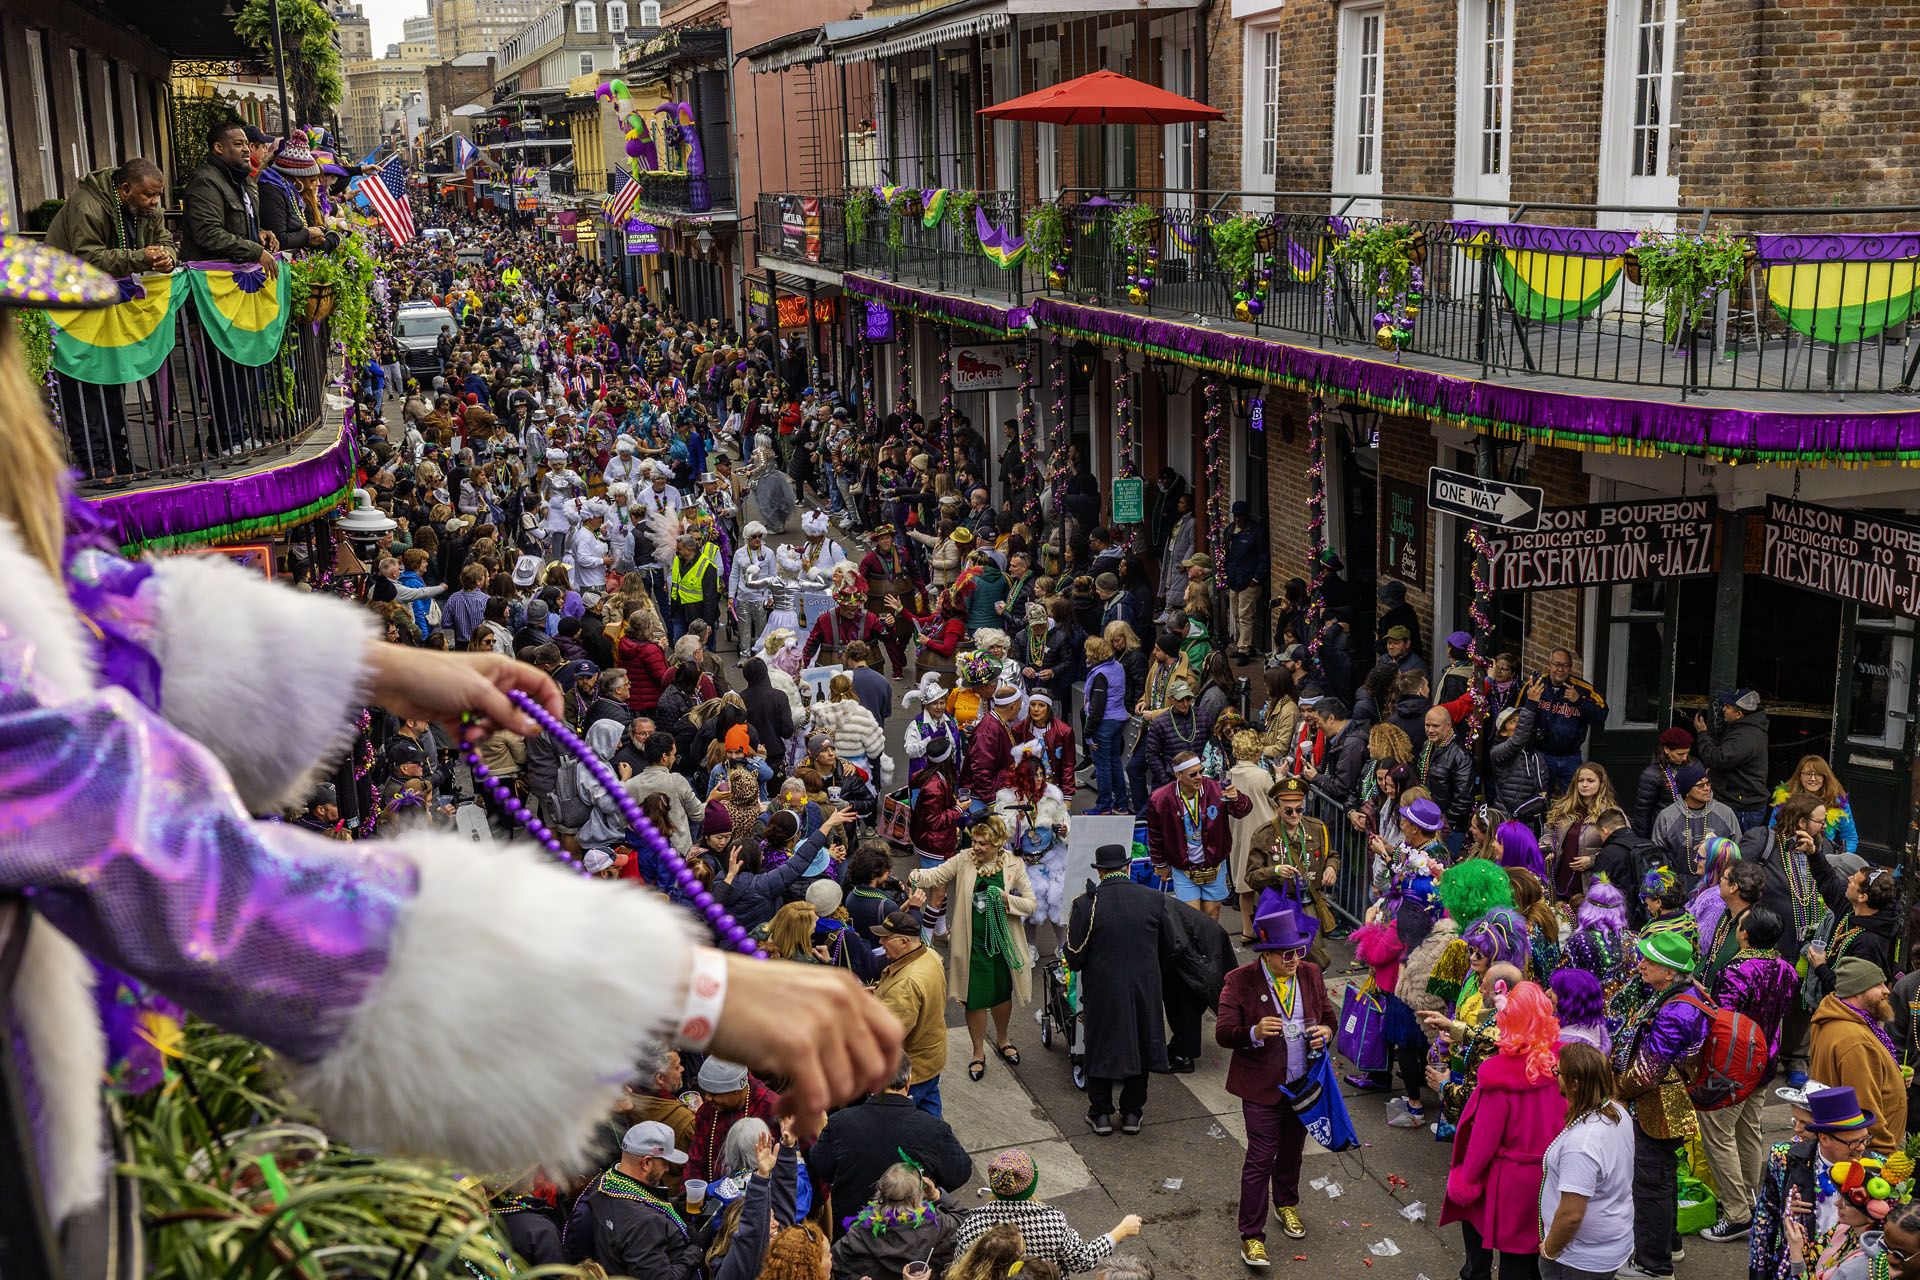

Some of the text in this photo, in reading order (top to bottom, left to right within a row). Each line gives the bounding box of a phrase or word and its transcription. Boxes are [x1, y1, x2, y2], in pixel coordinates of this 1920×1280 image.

[957, 369, 1005, 383] TICKLERS
[1439, 482, 1501, 512] ONE WAY
[1390, 512, 1414, 542] Julep
[1600, 501, 1707, 527] BOURBON
[1771, 501, 1920, 554] MAISON BOURB
[1512, 521, 1696, 550] DEDICATED TO THE
[1782, 524, 1859, 557] DEDICATED
[1871, 545, 1894, 565] TO
[1487, 523, 1713, 591] PRESERVATION OF JAZZ
[1761, 524, 1897, 609] PRESERVATION
[1895, 585, 1910, 598] OF
